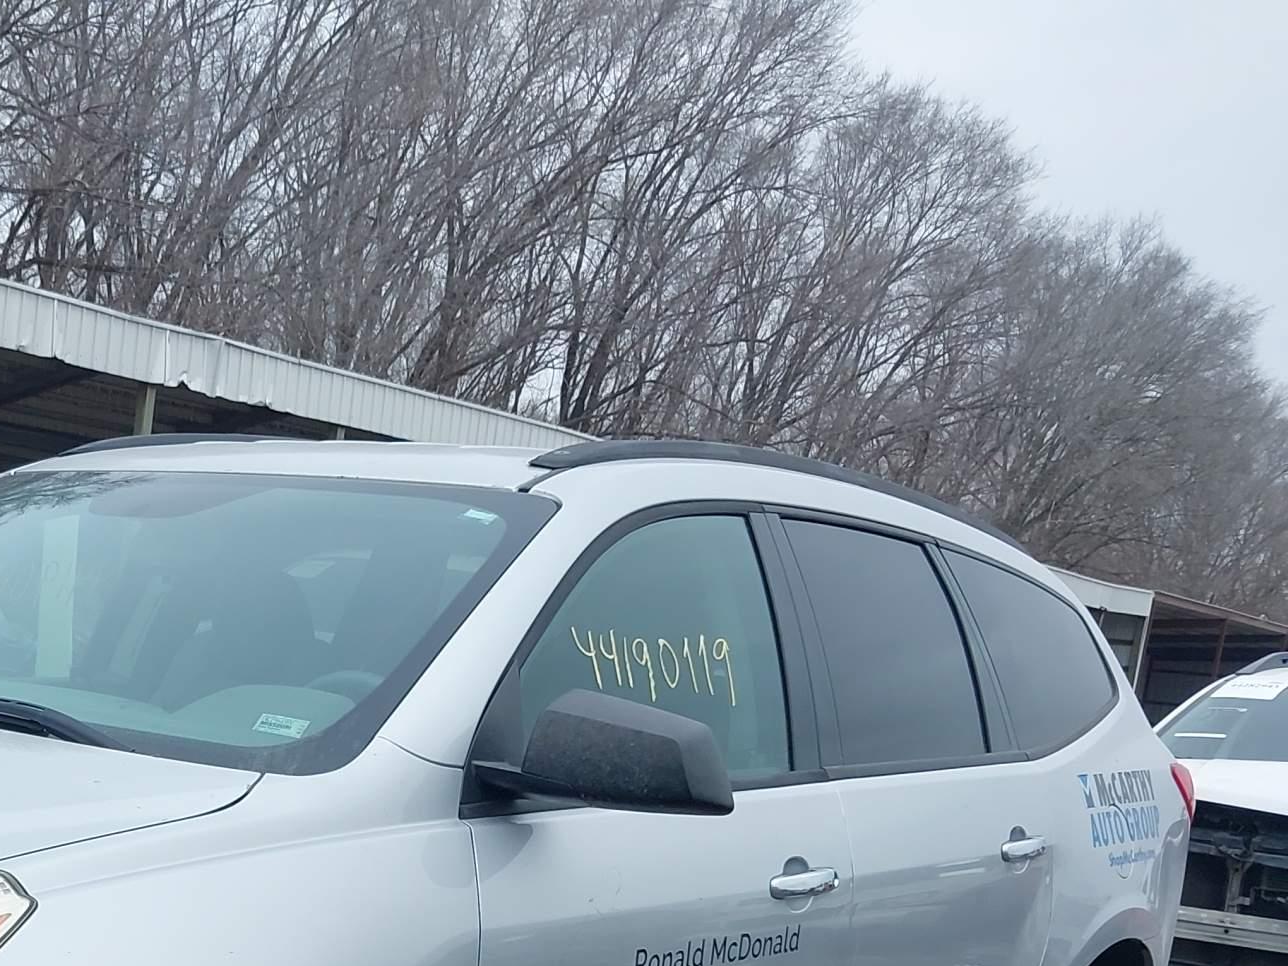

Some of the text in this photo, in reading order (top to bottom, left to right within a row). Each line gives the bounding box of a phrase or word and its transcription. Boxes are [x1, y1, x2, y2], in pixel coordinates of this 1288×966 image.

[571, 626, 736, 706] 44190119
[1090, 805, 1160, 849] AUTO GROUP
[710, 924, 801, 966] McDonald
